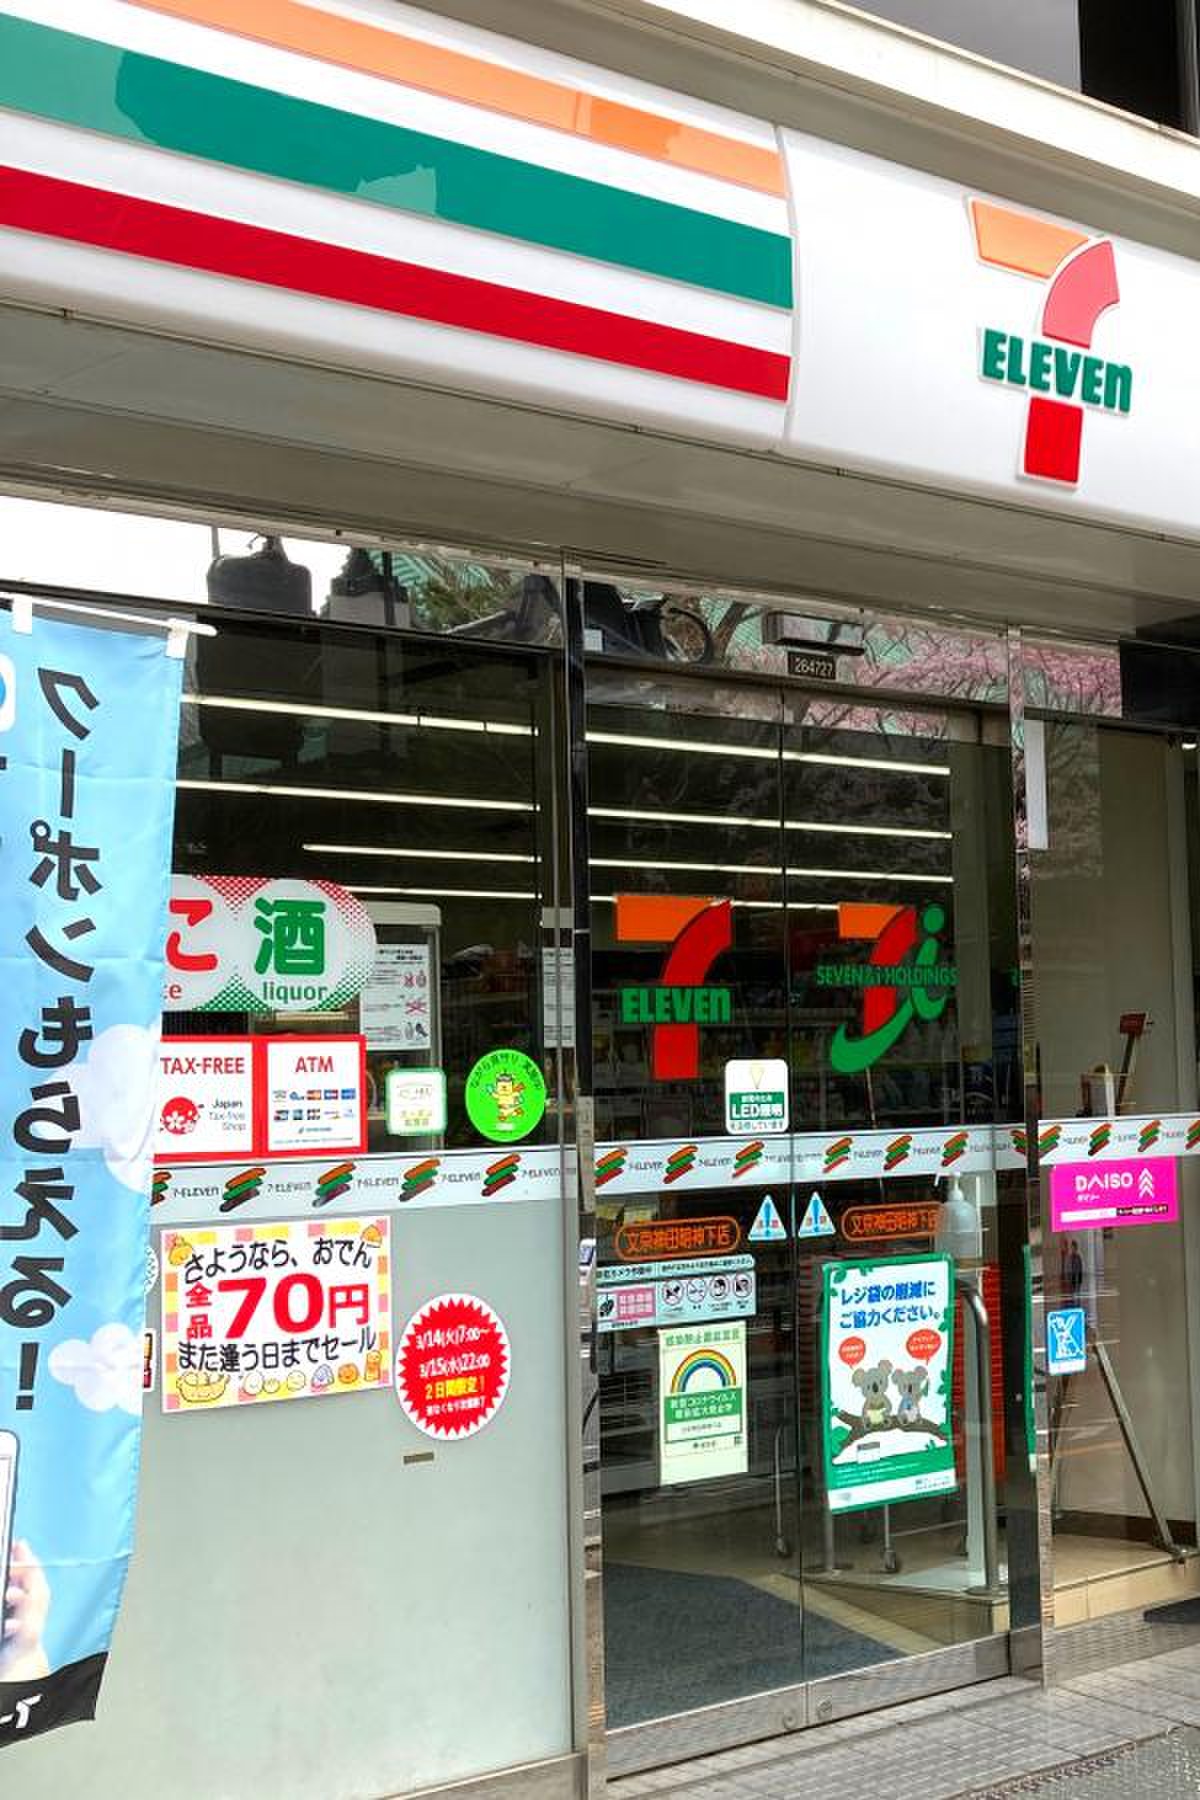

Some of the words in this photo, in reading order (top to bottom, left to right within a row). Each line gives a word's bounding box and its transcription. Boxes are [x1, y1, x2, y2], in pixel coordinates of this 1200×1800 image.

[254, 897, 326, 975] 酒
[262, 981, 328, 1004] liquor
[160, 1057, 245, 1075] TAX-FREE
[295, 1056, 334, 1073] ATM
[211, 1099, 243, 1109] Japan
[222, 1121, 246, 1132] Shop
[1075, 1172, 1134, 1192] DAISO
[840, 1280, 937, 1306] レジ袋の削減に
[185, 1282, 213, 1340] 全品
[217, 1272, 371, 1340] 70円
[839, 1305, 941, 1330] ご協力ください。
[177, 1326, 377, 1373] また逢う日までセール
